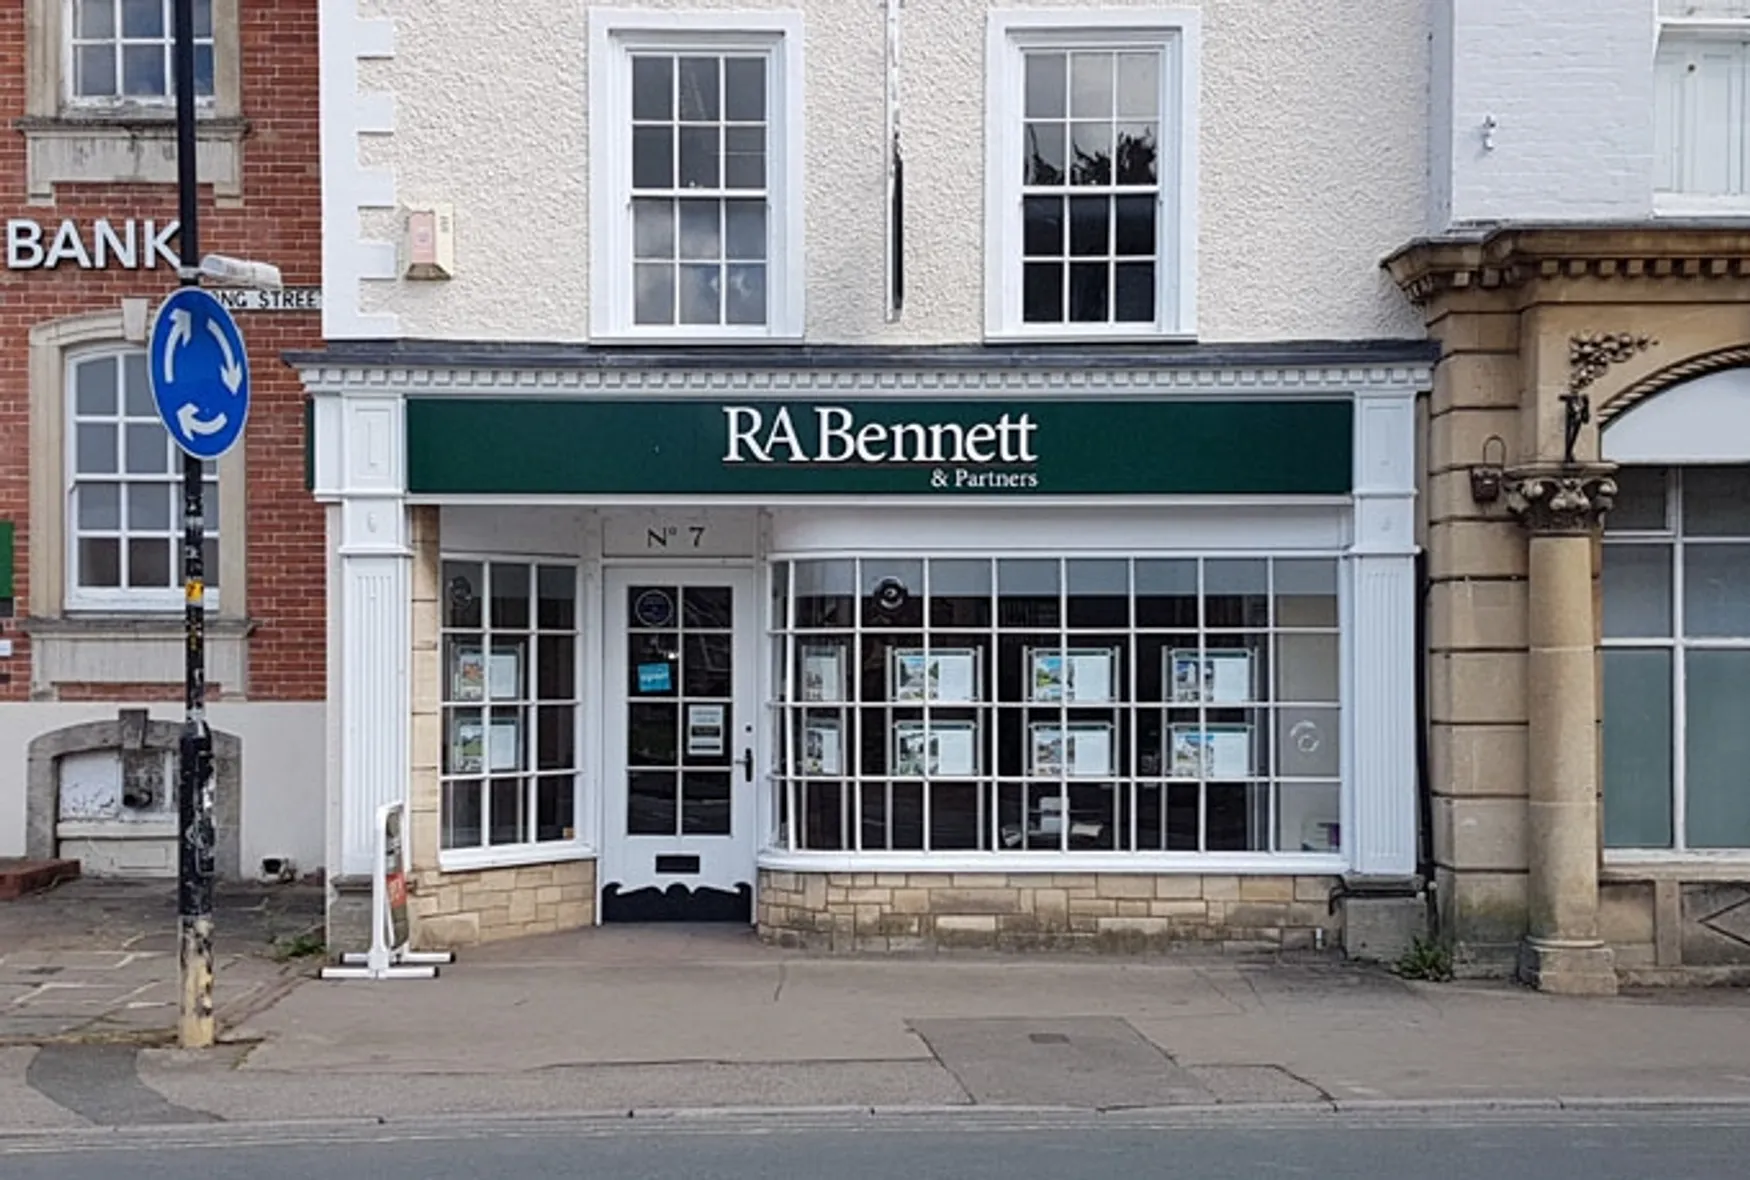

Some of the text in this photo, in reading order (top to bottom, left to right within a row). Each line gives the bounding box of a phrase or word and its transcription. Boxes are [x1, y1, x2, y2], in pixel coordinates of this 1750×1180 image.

[7, 219, 181, 269] BANK
[213, 290, 248, 307] NG
[722, 406, 1038, 462] RA Bennett
[930, 467, 1038, 487] & Partners
[688, 526, 705, 548] 7
